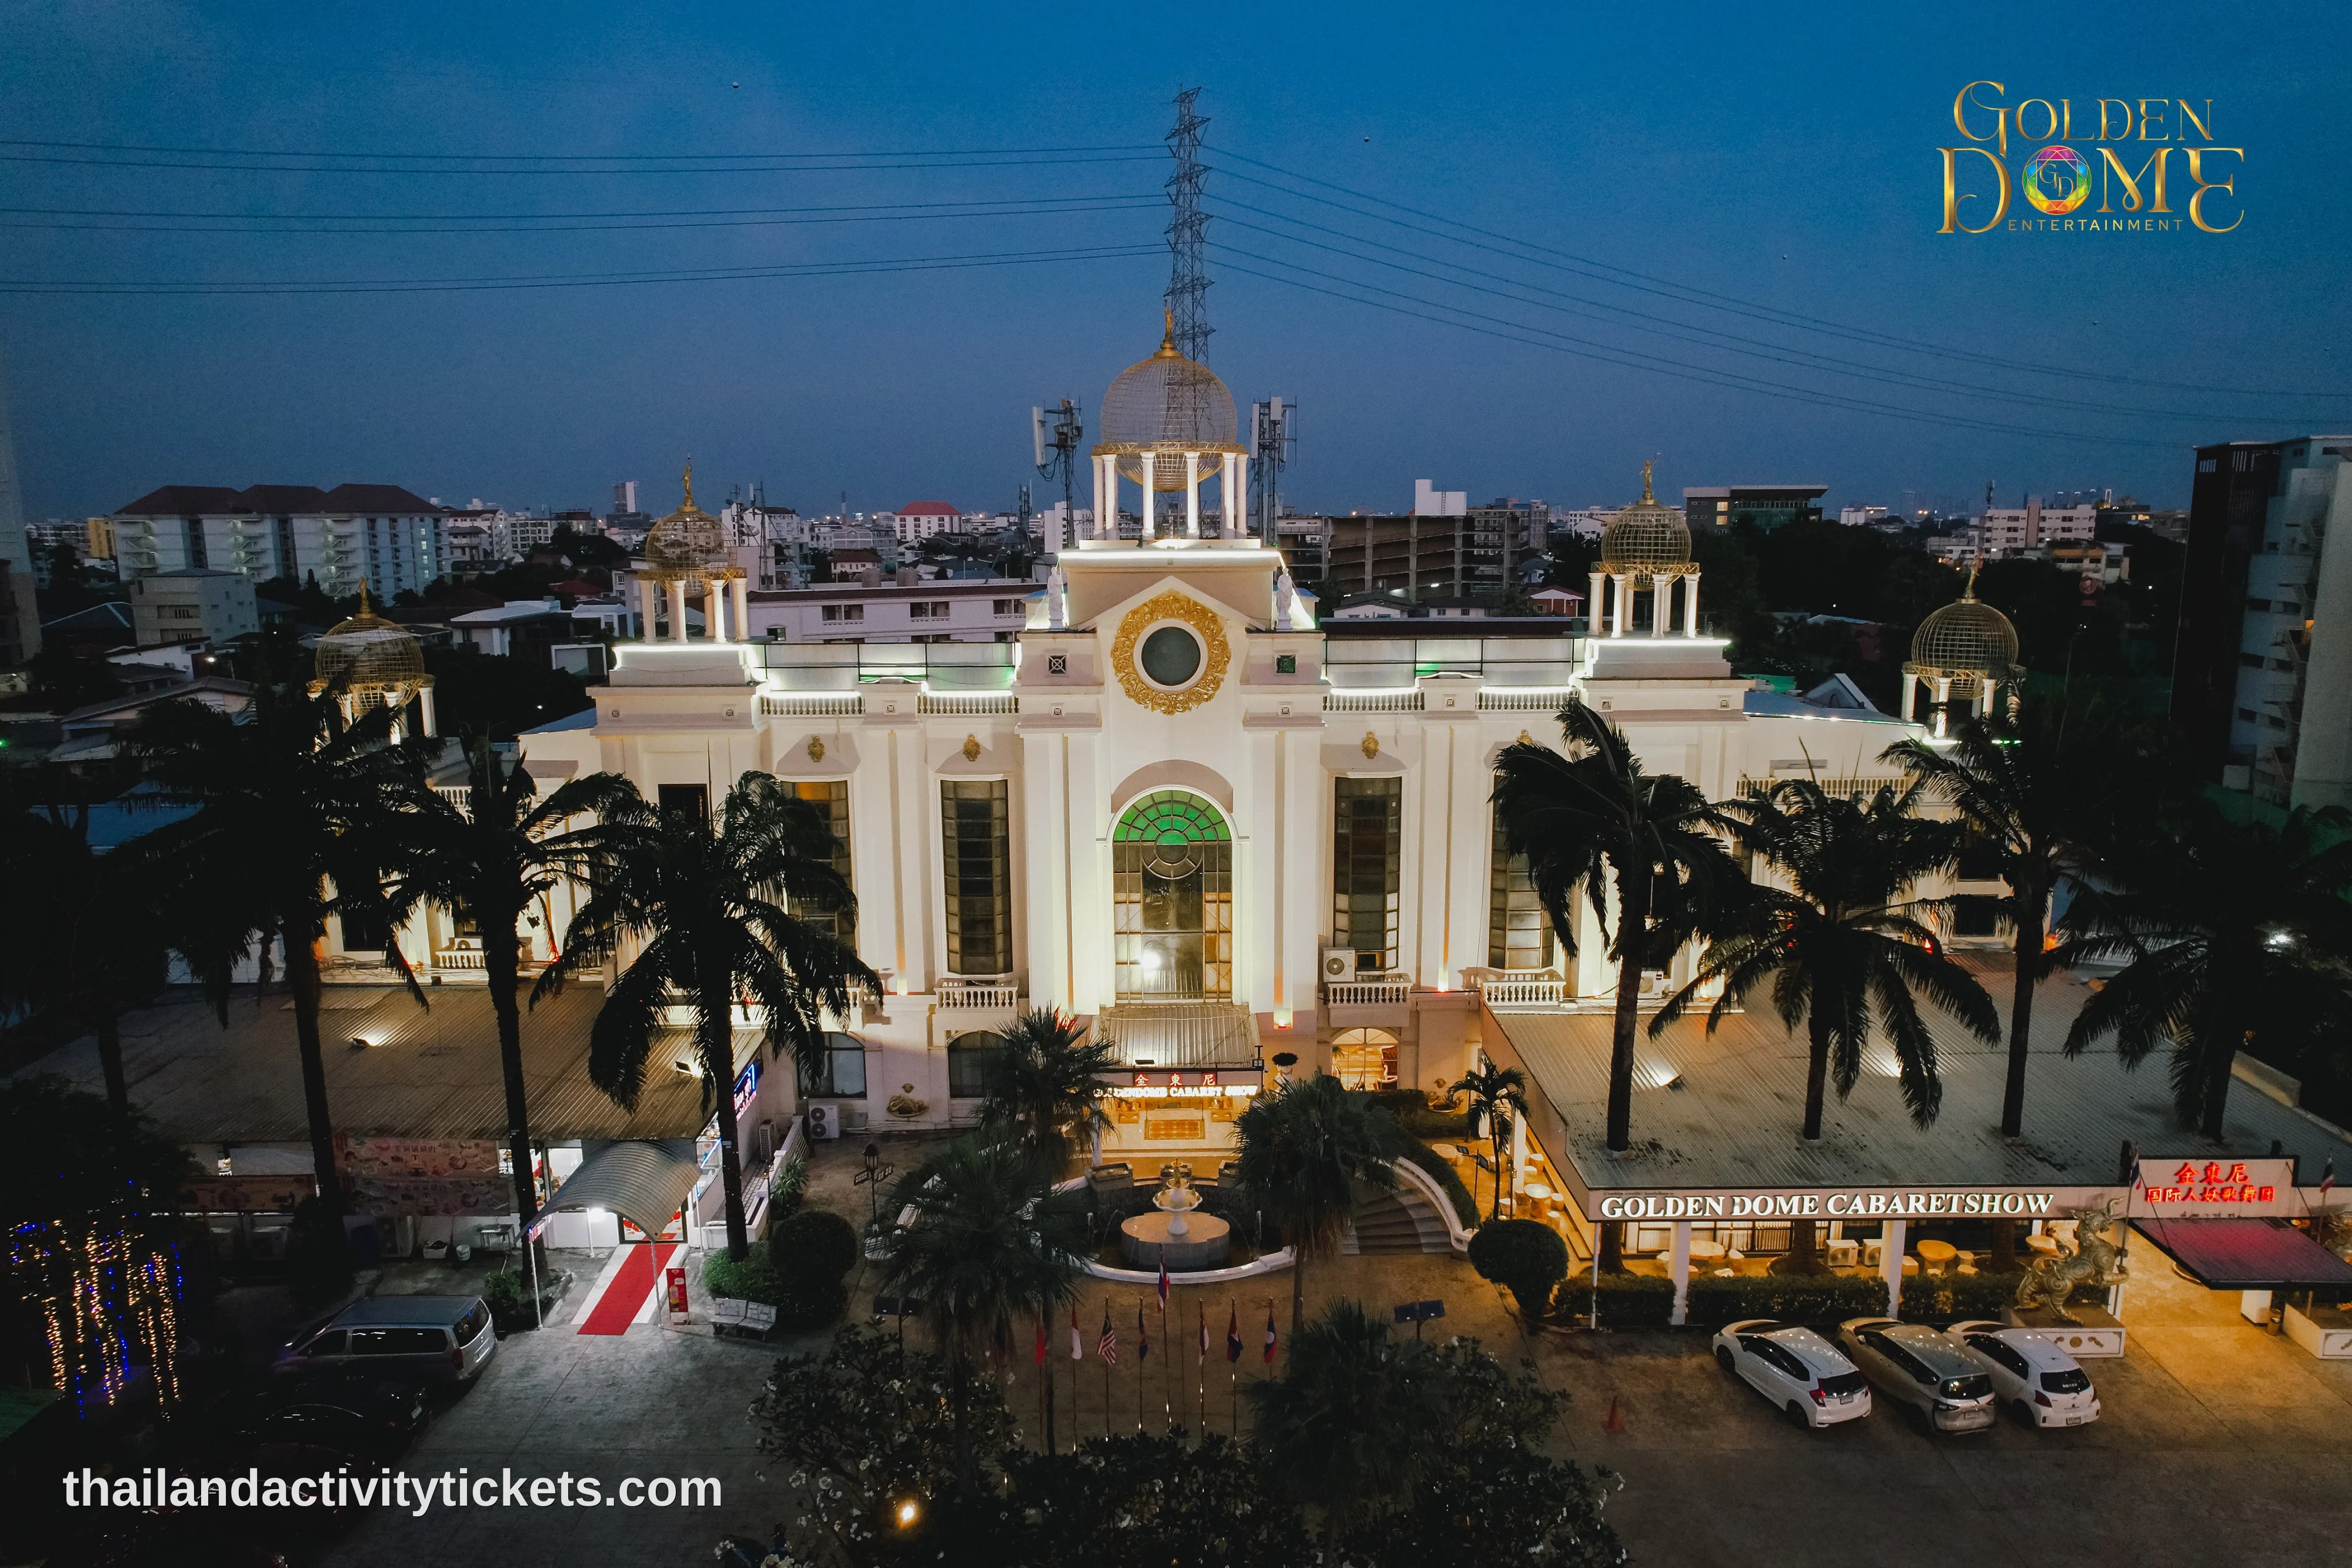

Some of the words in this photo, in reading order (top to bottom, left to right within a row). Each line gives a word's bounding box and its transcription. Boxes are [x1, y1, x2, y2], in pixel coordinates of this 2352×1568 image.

[1135, 1073, 1216, 1086] 金東尼
[1169, 1086, 1223, 1097] CABARET
[1225, 1085, 1258, 1096] SHOW
[2174, 1162, 2250, 1185] 金東尼
[2146, 1185, 2276, 1203] 国际人妖歌舞团
[1601, 1196, 1724, 1218] GOLDEN
[1732, 1195, 1819, 1216] DOME
[1826, 1193, 2054, 1215] CABARETSHOW
